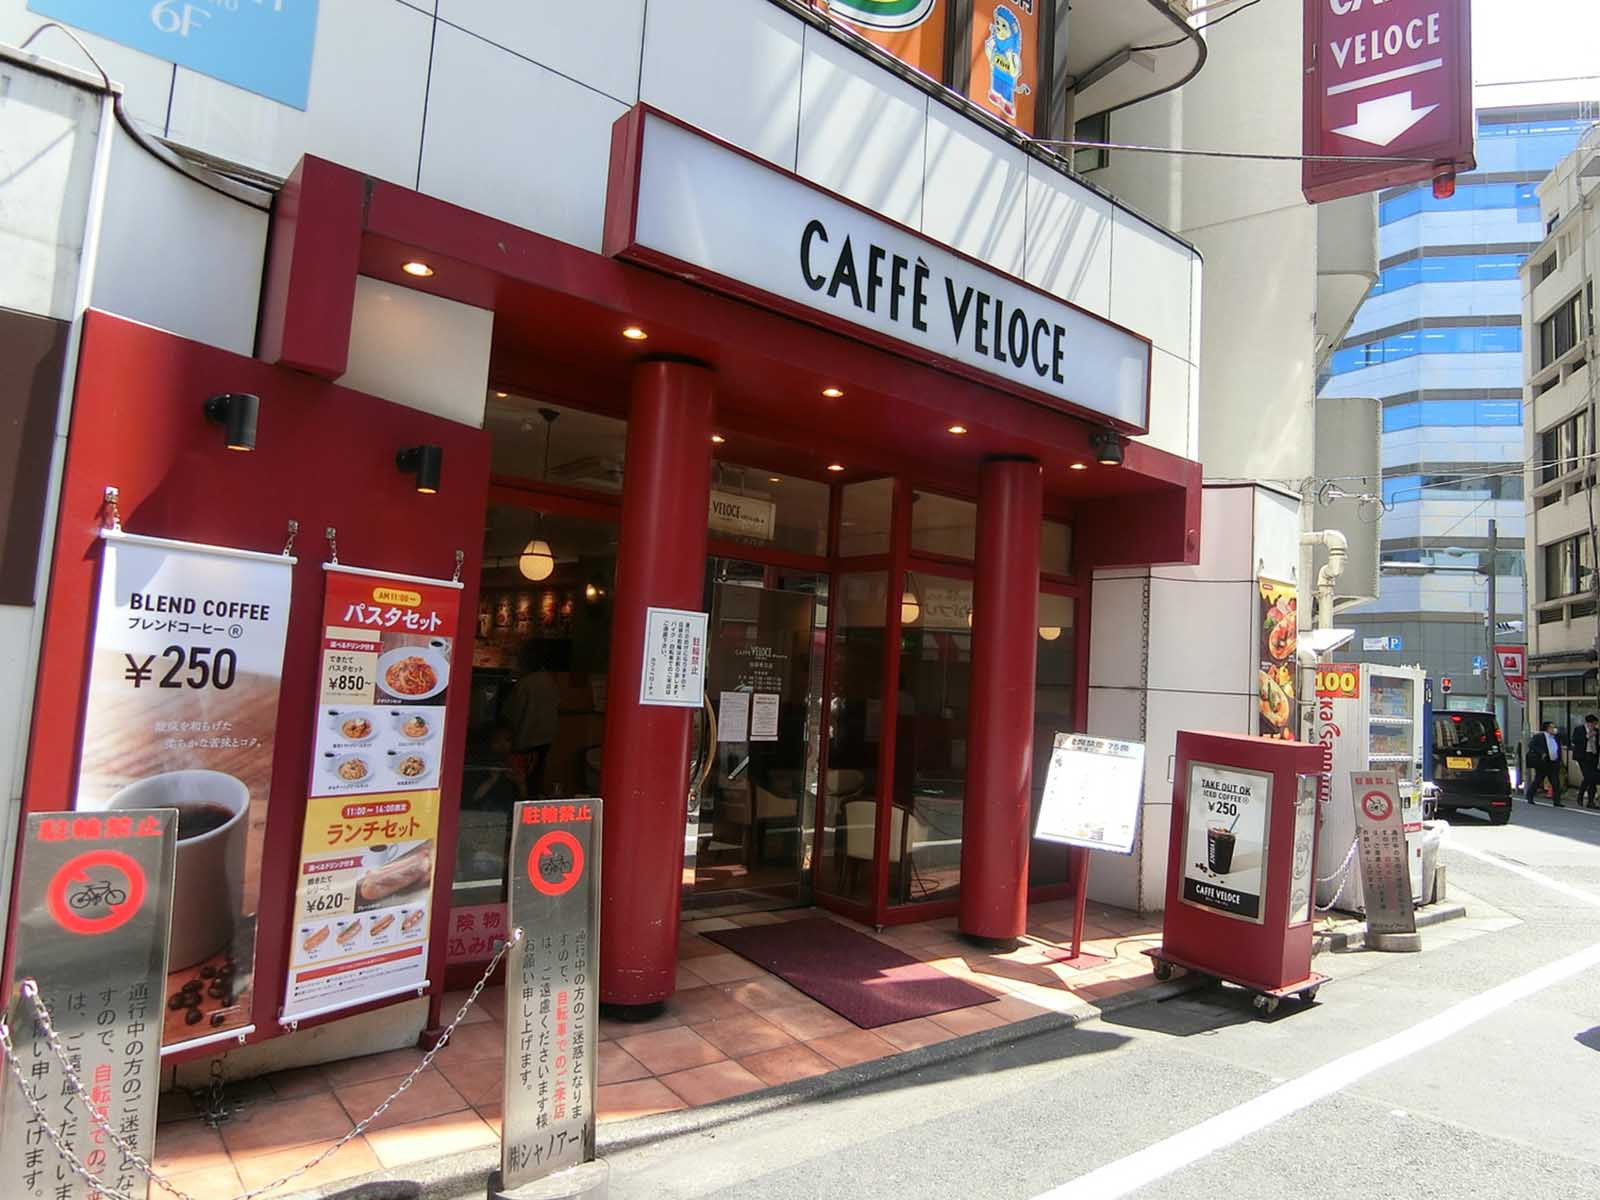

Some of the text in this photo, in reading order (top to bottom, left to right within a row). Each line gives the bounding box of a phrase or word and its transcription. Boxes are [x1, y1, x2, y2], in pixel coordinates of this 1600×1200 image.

[1330, 12, 1440, 69] VELOCE
[800, 219, 1066, 384] CAFFÈ VELOCE
[130, 592, 270, 621] BLEND COFFEE
[343, 603, 442, 631] パスタセット
[124, 645, 237, 690] ¥250
[1202, 779, 1220, 790] TAKE
[522, 804, 593, 824] 駐輪禁止
[38, 815, 163, 842] 駐輪禁止
[327, 816, 420, 845] ランチセット
[1216, 889, 1241, 905] VELOCE
